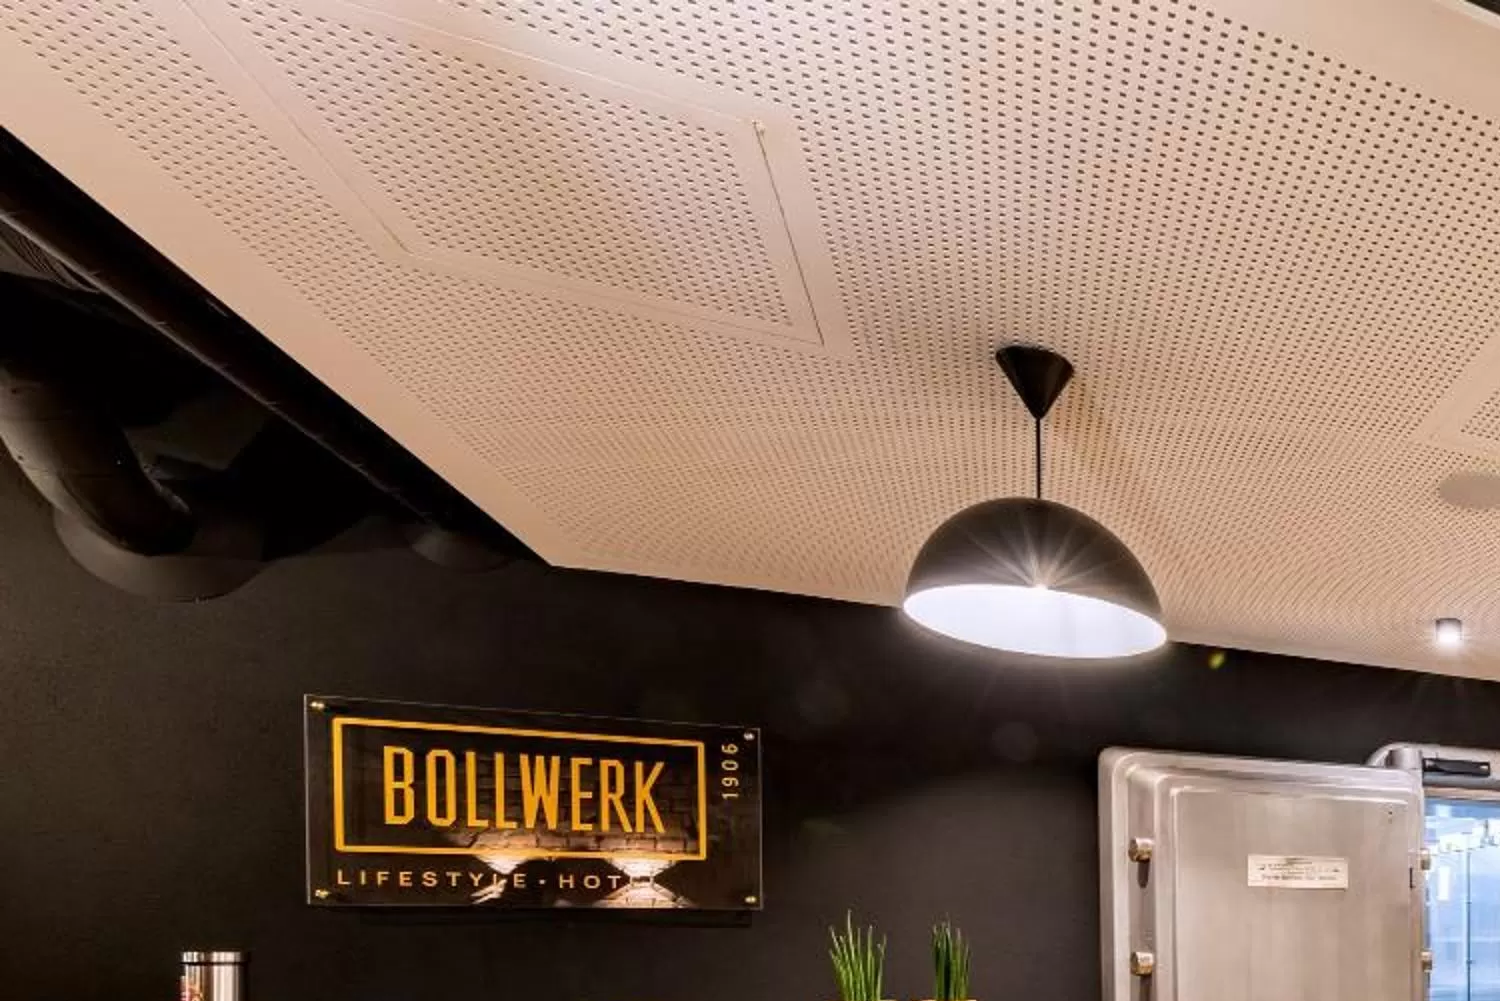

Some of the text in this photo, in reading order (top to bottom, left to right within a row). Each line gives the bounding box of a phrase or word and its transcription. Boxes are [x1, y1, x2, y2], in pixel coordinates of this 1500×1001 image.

[383, 745, 666, 833] BOLLWERK
[721, 743, 739, 799] 1906
[337, 869, 662, 890] LIFESTYLE HOT
